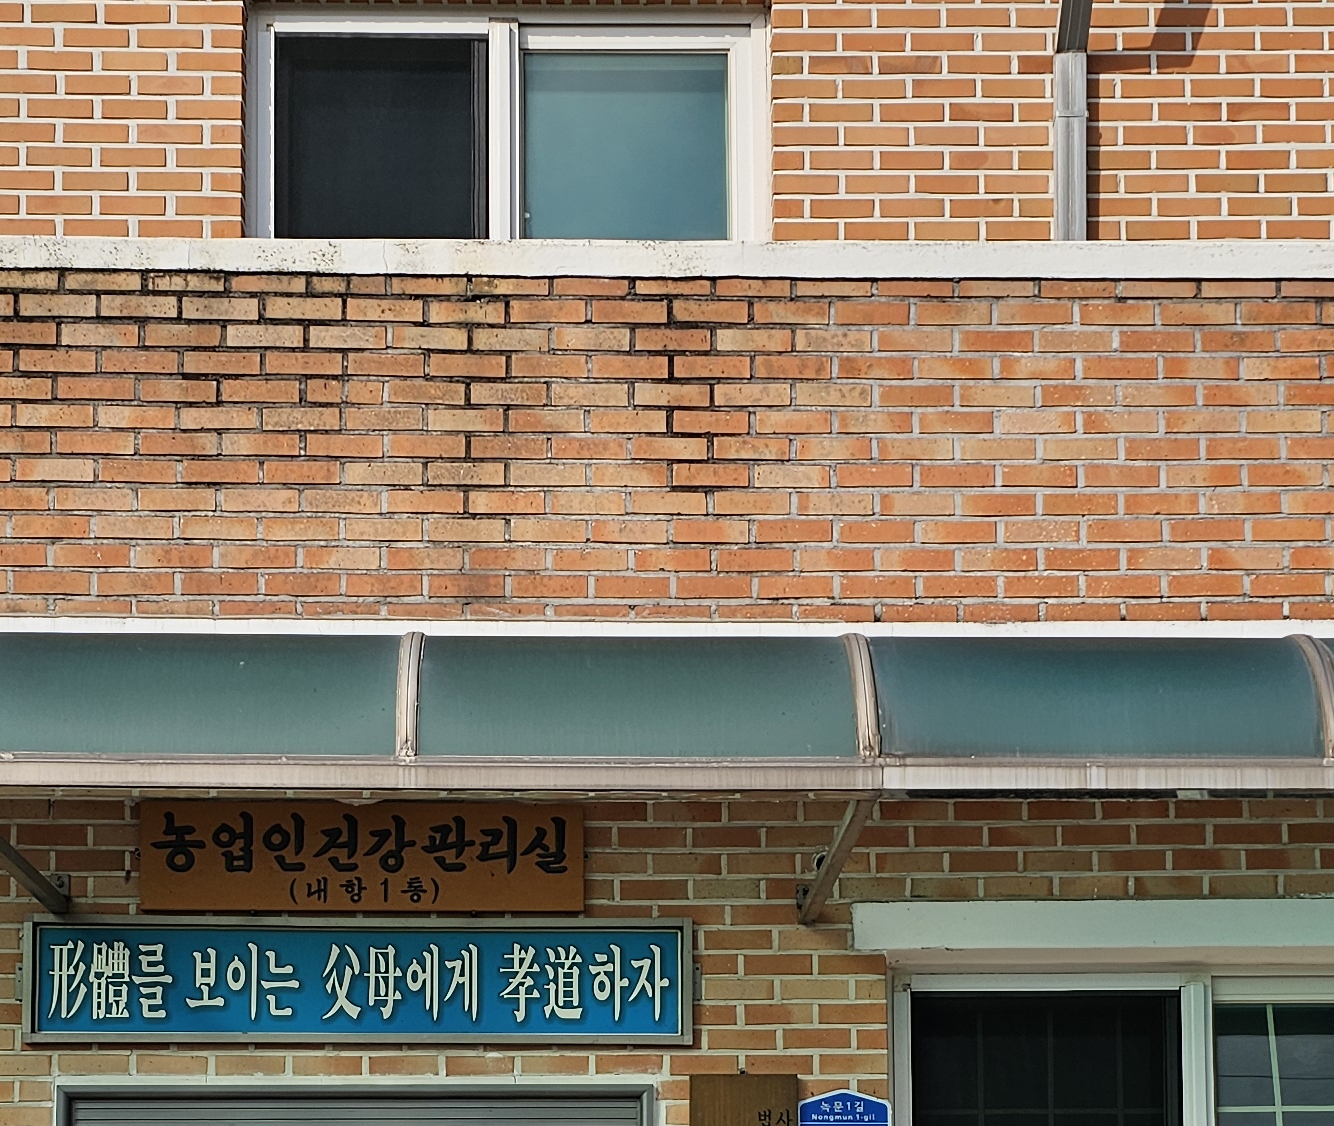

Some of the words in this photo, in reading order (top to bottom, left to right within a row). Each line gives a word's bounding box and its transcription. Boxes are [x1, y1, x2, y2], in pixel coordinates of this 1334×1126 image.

[150, 810, 569, 876] 농업인건강관리실
[185, 941, 302, 1021] 보이는
[322, 942, 480, 1021] 父母에게
[499, 942, 671, 1022] 孝道하자
[811, 1113, 854, 1121] Nongmun
[820, 1100, 864, 1113] 녹문1길
